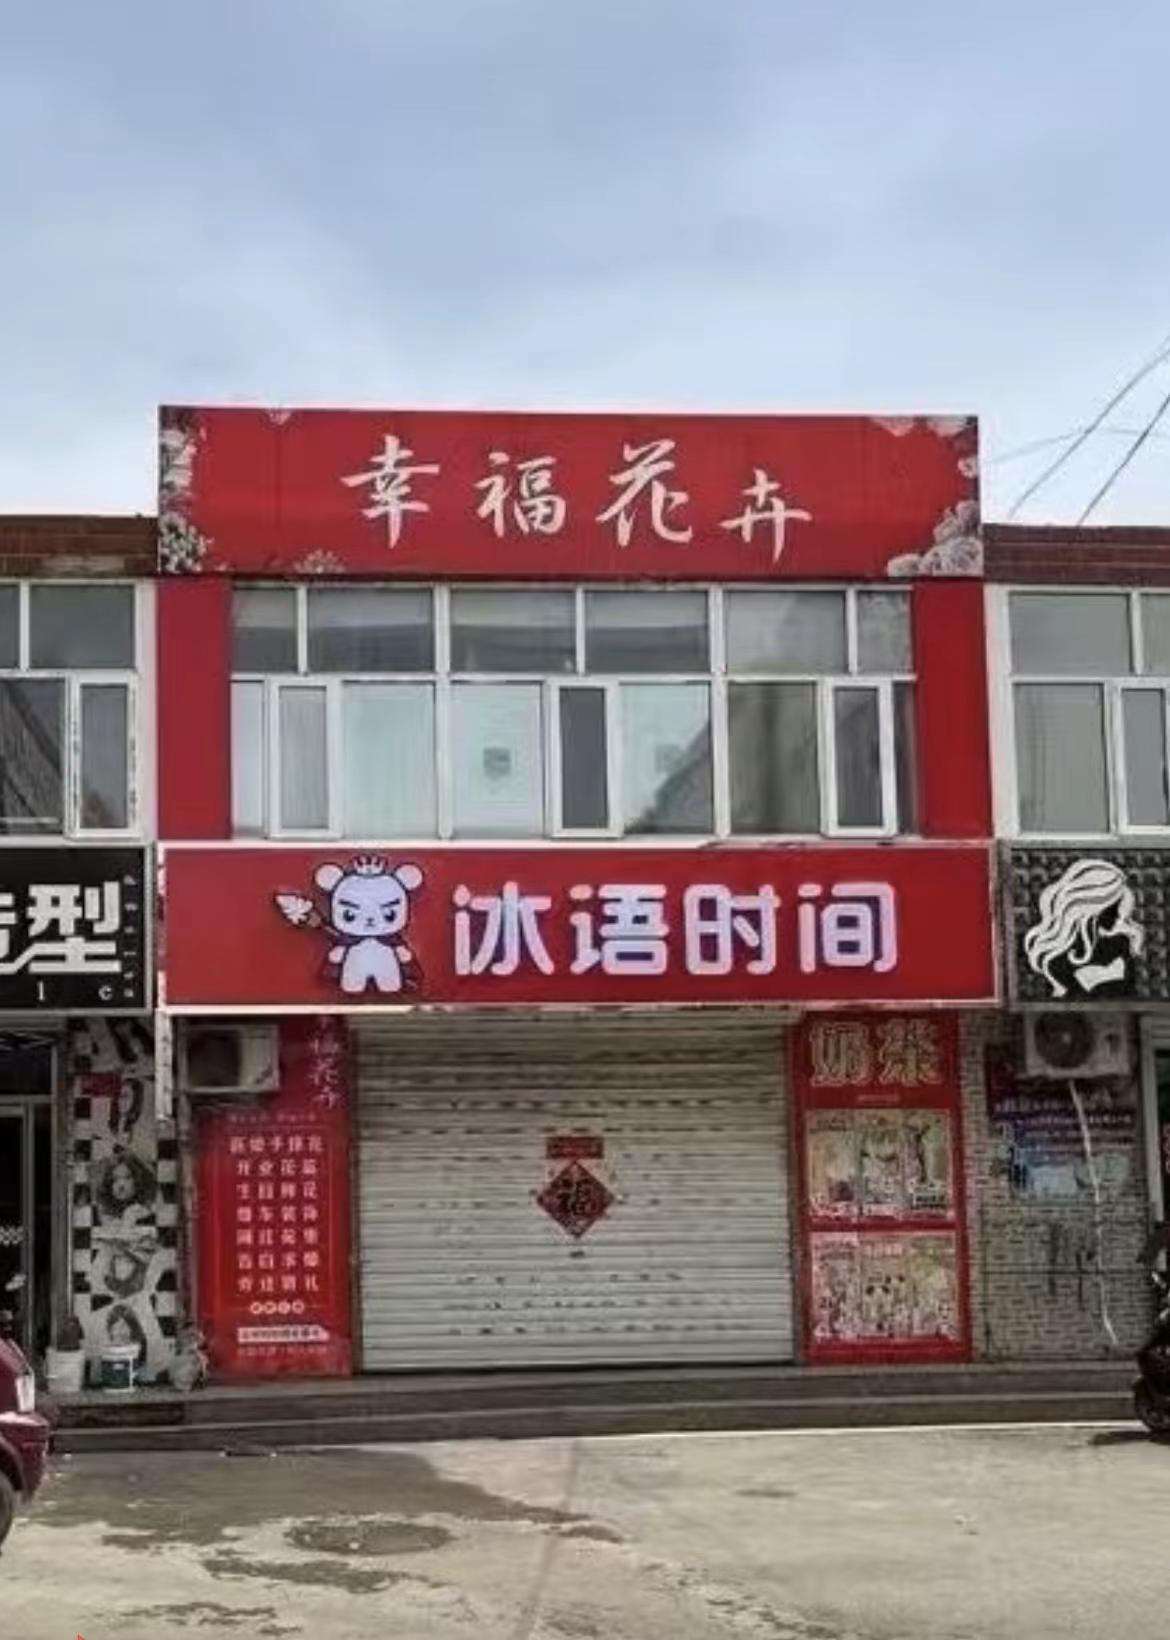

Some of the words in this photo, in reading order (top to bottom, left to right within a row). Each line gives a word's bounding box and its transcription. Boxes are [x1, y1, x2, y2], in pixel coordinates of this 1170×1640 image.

[341, 435, 812, 563] 幸福花卉
[453, 881, 898, 976] 冰语时间
